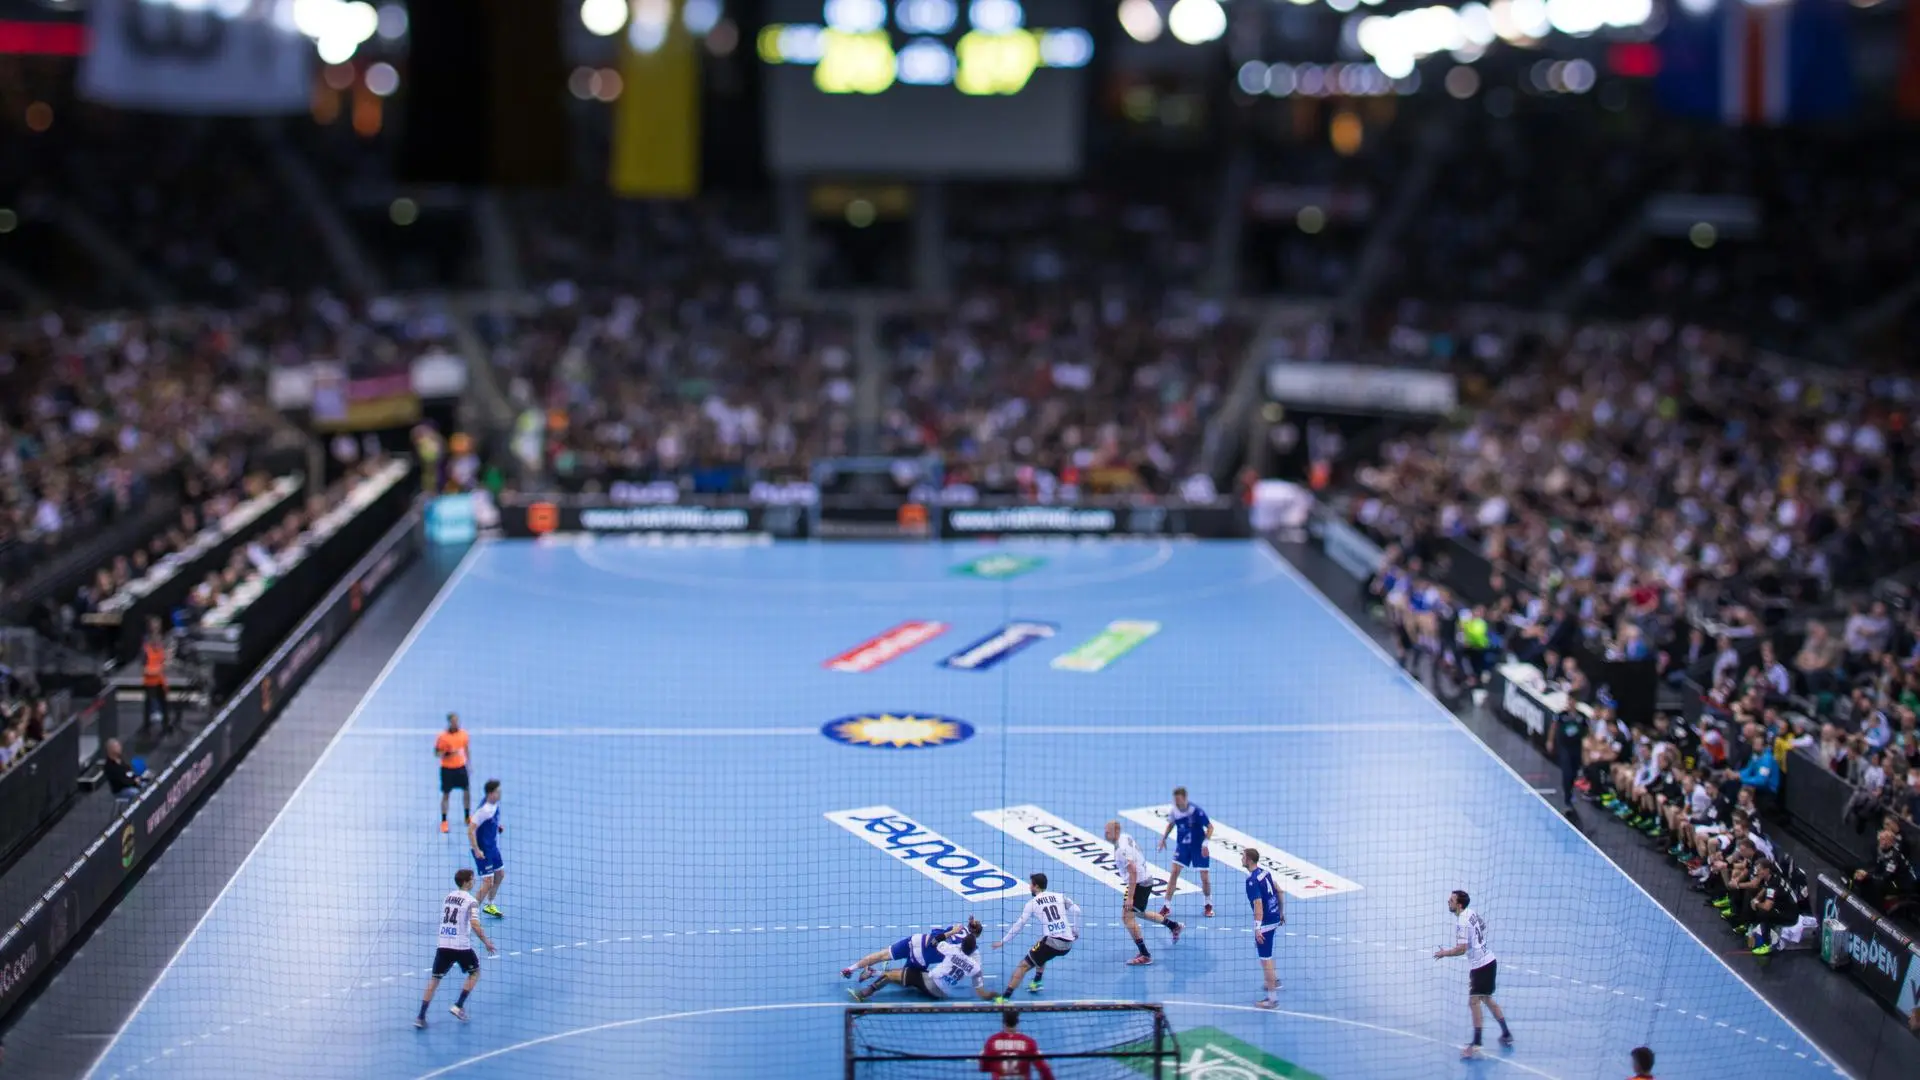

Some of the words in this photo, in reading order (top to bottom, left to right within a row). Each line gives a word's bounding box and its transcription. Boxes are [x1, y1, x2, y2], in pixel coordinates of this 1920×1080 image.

[849, 811, 1017, 895] brother
[443, 907, 458, 925] 34
[1043, 905, 1060, 922] 10
[441, 927, 457, 935] DKB
[1048, 922, 1065, 932] DKB
